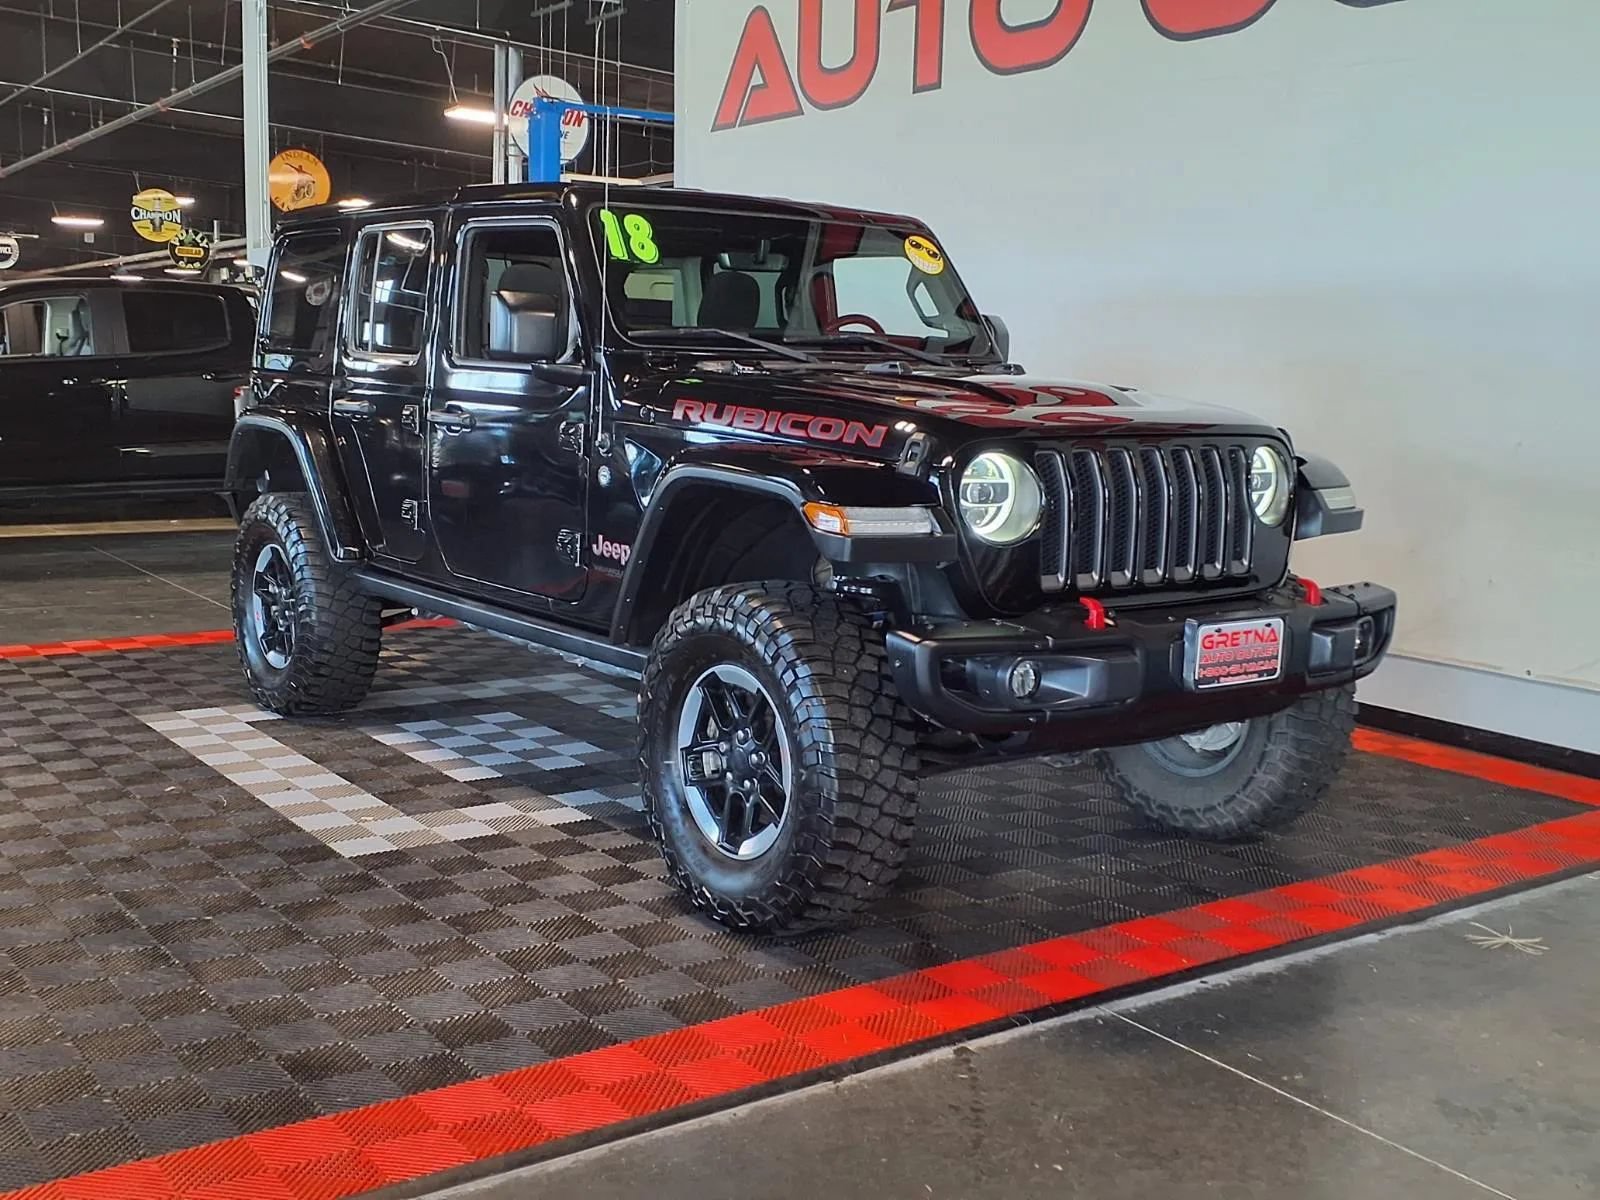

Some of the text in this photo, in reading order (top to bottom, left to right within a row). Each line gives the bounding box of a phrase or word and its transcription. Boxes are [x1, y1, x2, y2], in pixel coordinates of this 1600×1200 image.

[599, 208, 660, 265] 18
[671, 399, 889, 448] RUBICON
[591, 534, 631, 566] Jeep
[1200, 647, 1278, 663] AUTO OUTLET
[1202, 628, 1278, 650] GRETNA
